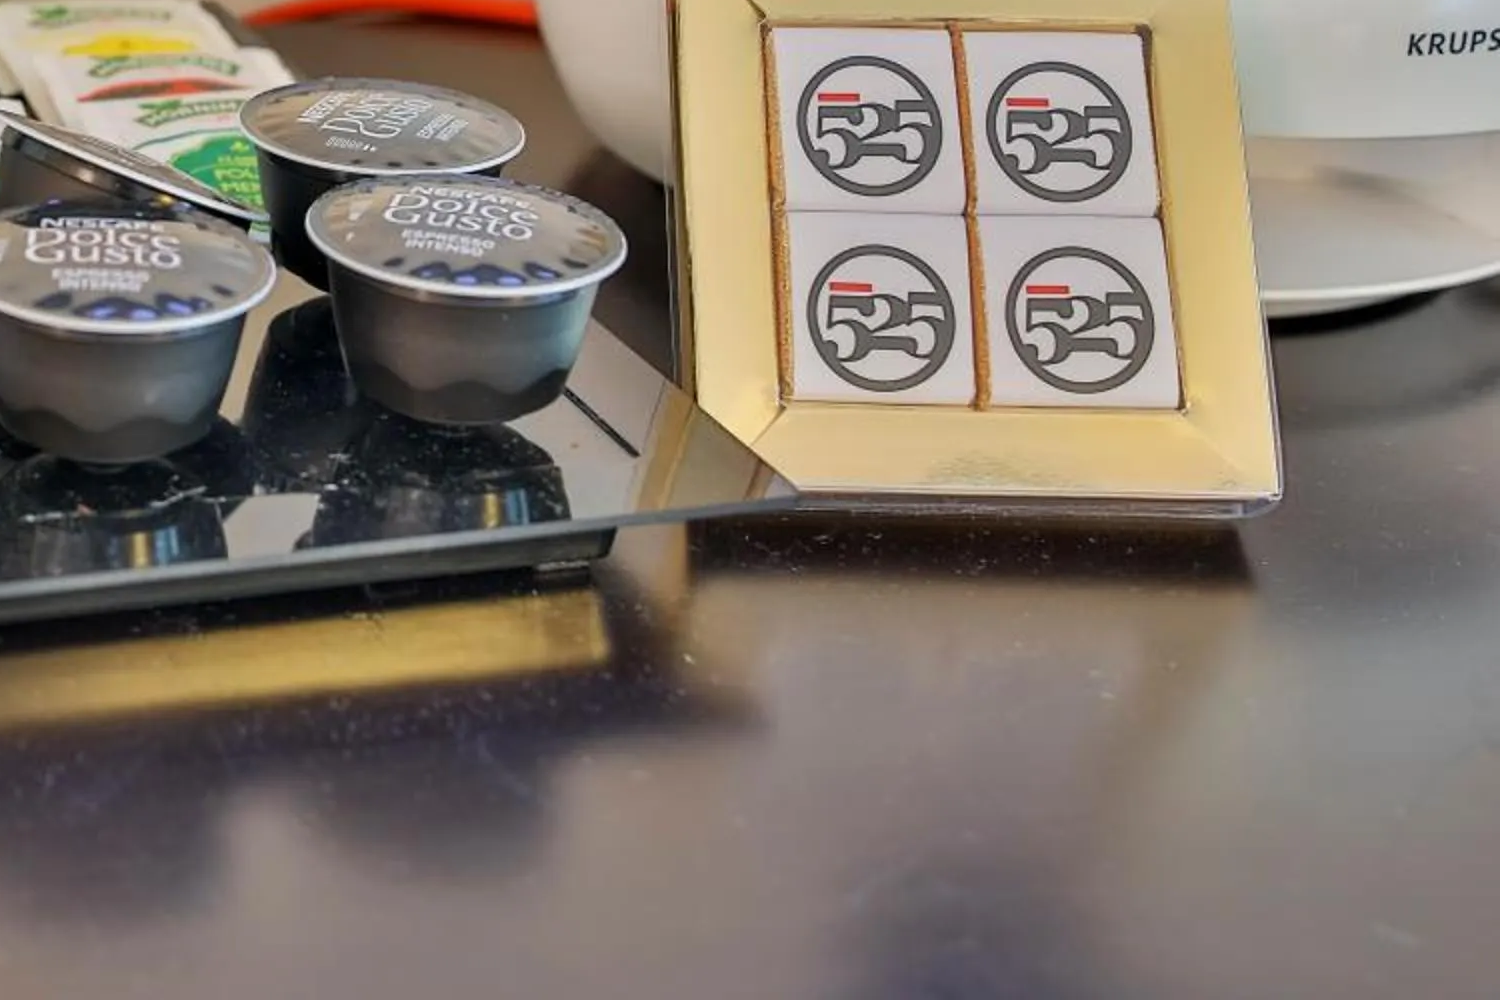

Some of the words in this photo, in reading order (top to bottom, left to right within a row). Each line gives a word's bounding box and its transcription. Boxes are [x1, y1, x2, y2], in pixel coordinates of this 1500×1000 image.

[1407, 28, 1500, 56] KRUPS
[384, 206, 534, 241] Gusto
[389, 193, 540, 227] Dolce
[27, 228, 181, 250] Dolce
[25, 245, 182, 270] Gusto
